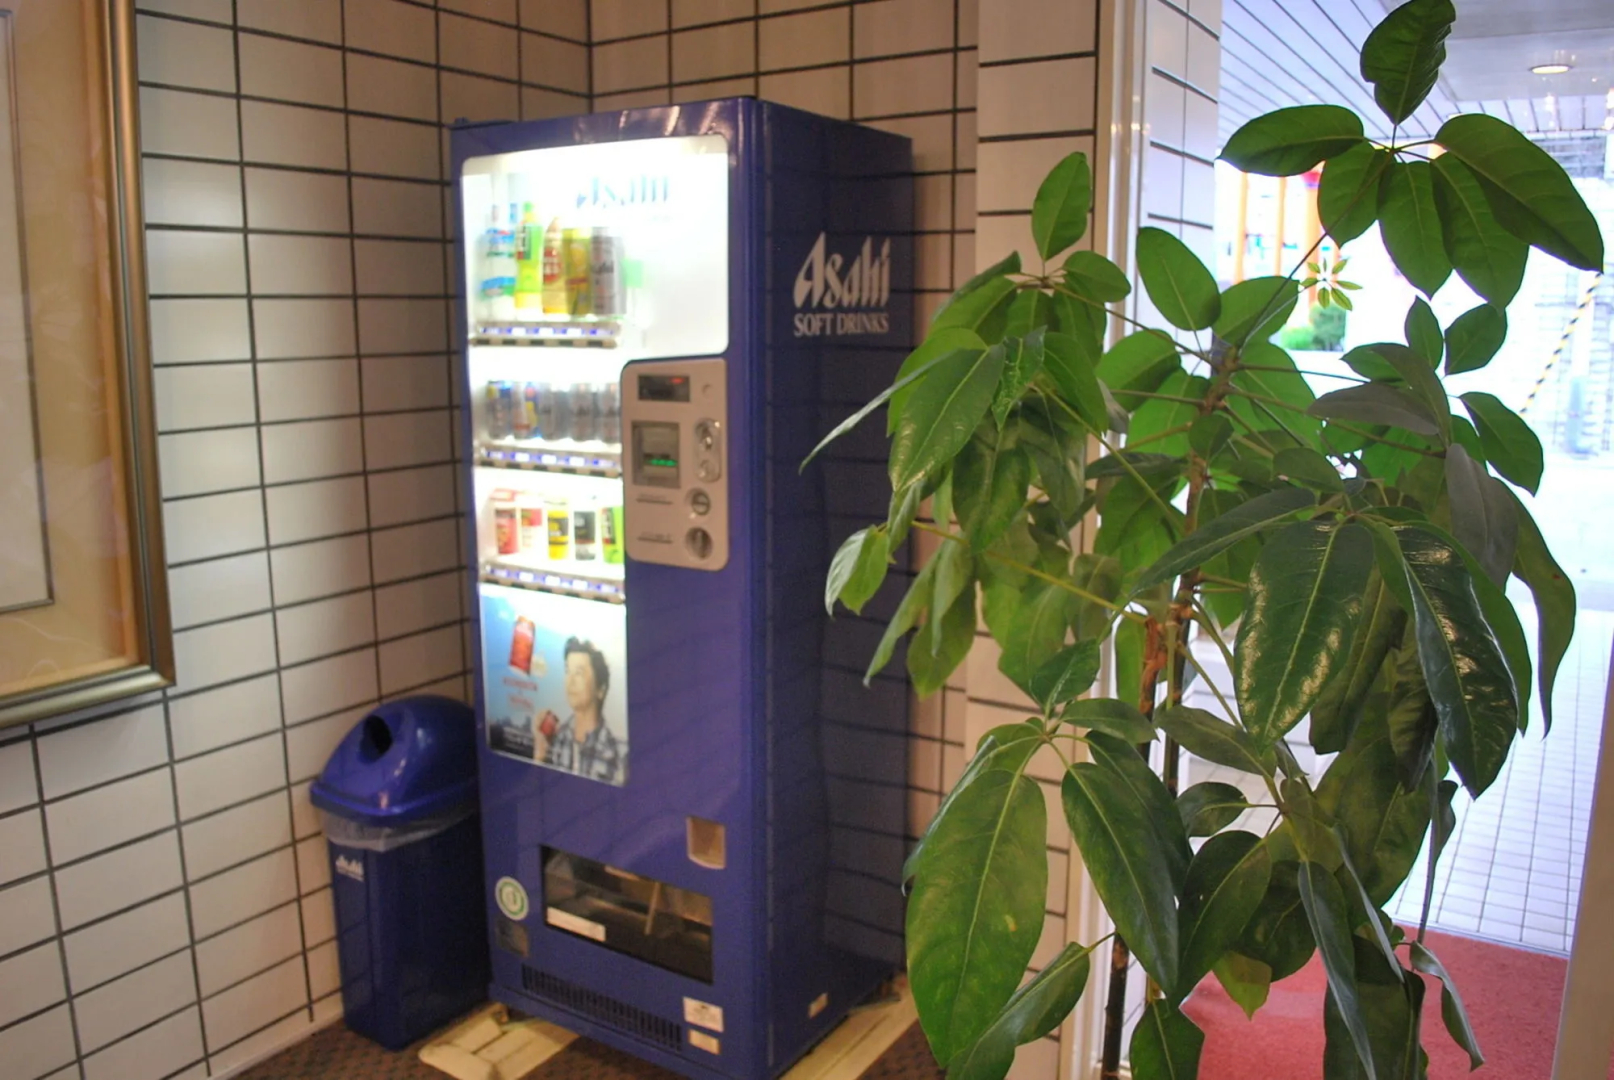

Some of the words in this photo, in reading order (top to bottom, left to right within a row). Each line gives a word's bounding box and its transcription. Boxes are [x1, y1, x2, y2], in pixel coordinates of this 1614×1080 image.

[793, 230, 891, 309] Asahi
[794, 313, 834, 338] SOFT
[836, 311, 890, 336] DRINKS
